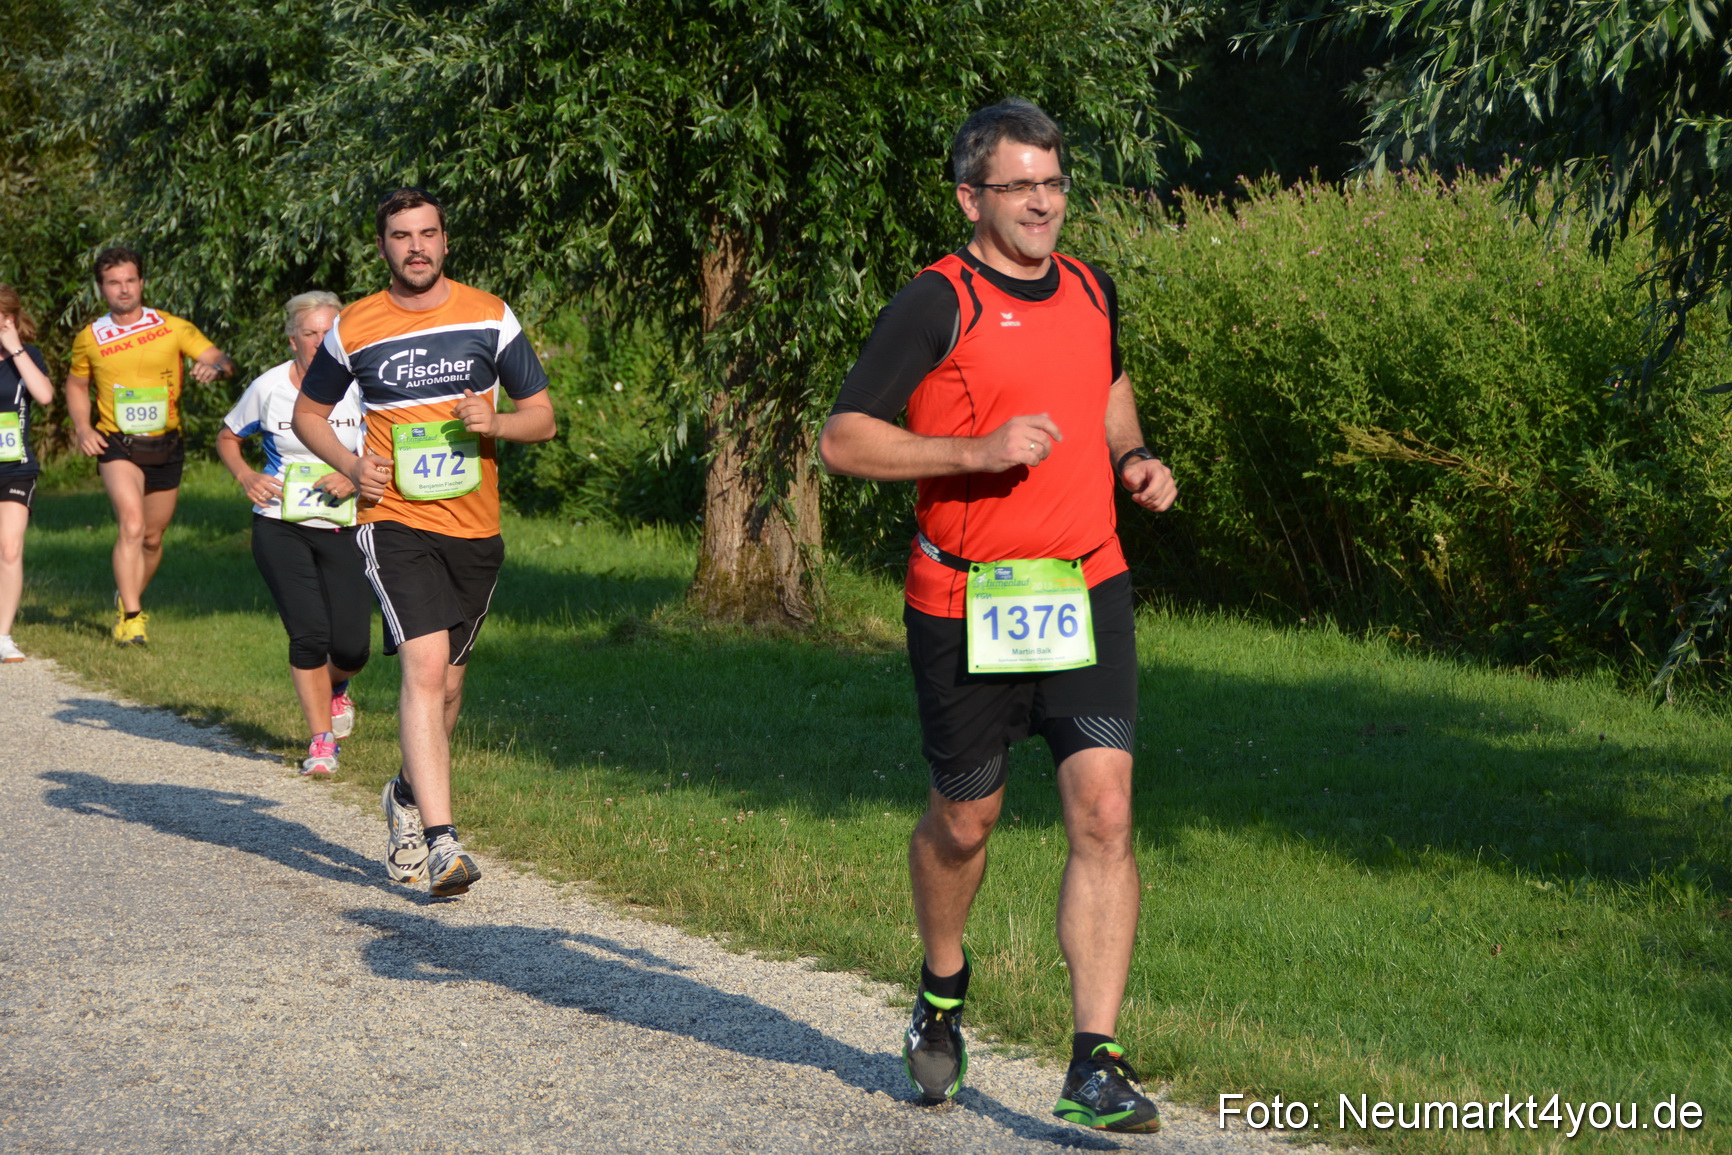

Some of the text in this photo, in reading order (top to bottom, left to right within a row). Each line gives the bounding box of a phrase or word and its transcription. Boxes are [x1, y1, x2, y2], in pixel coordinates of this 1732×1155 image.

[100, 326, 173, 357] MAX BÖGL
[396, 357, 474, 380] Fischer
[405, 374, 471, 388] AUTOMOBILE
[126, 406, 158, 421] 898
[278, 418, 355, 430] DPHI
[413, 451, 466, 478] 472
[418, 481, 444, 490] Benjamin
[986, 578, 1030, 587] firmenlauf
[982, 603, 1079, 640] 1376
[1011, 647, 1035, 655] Martin
